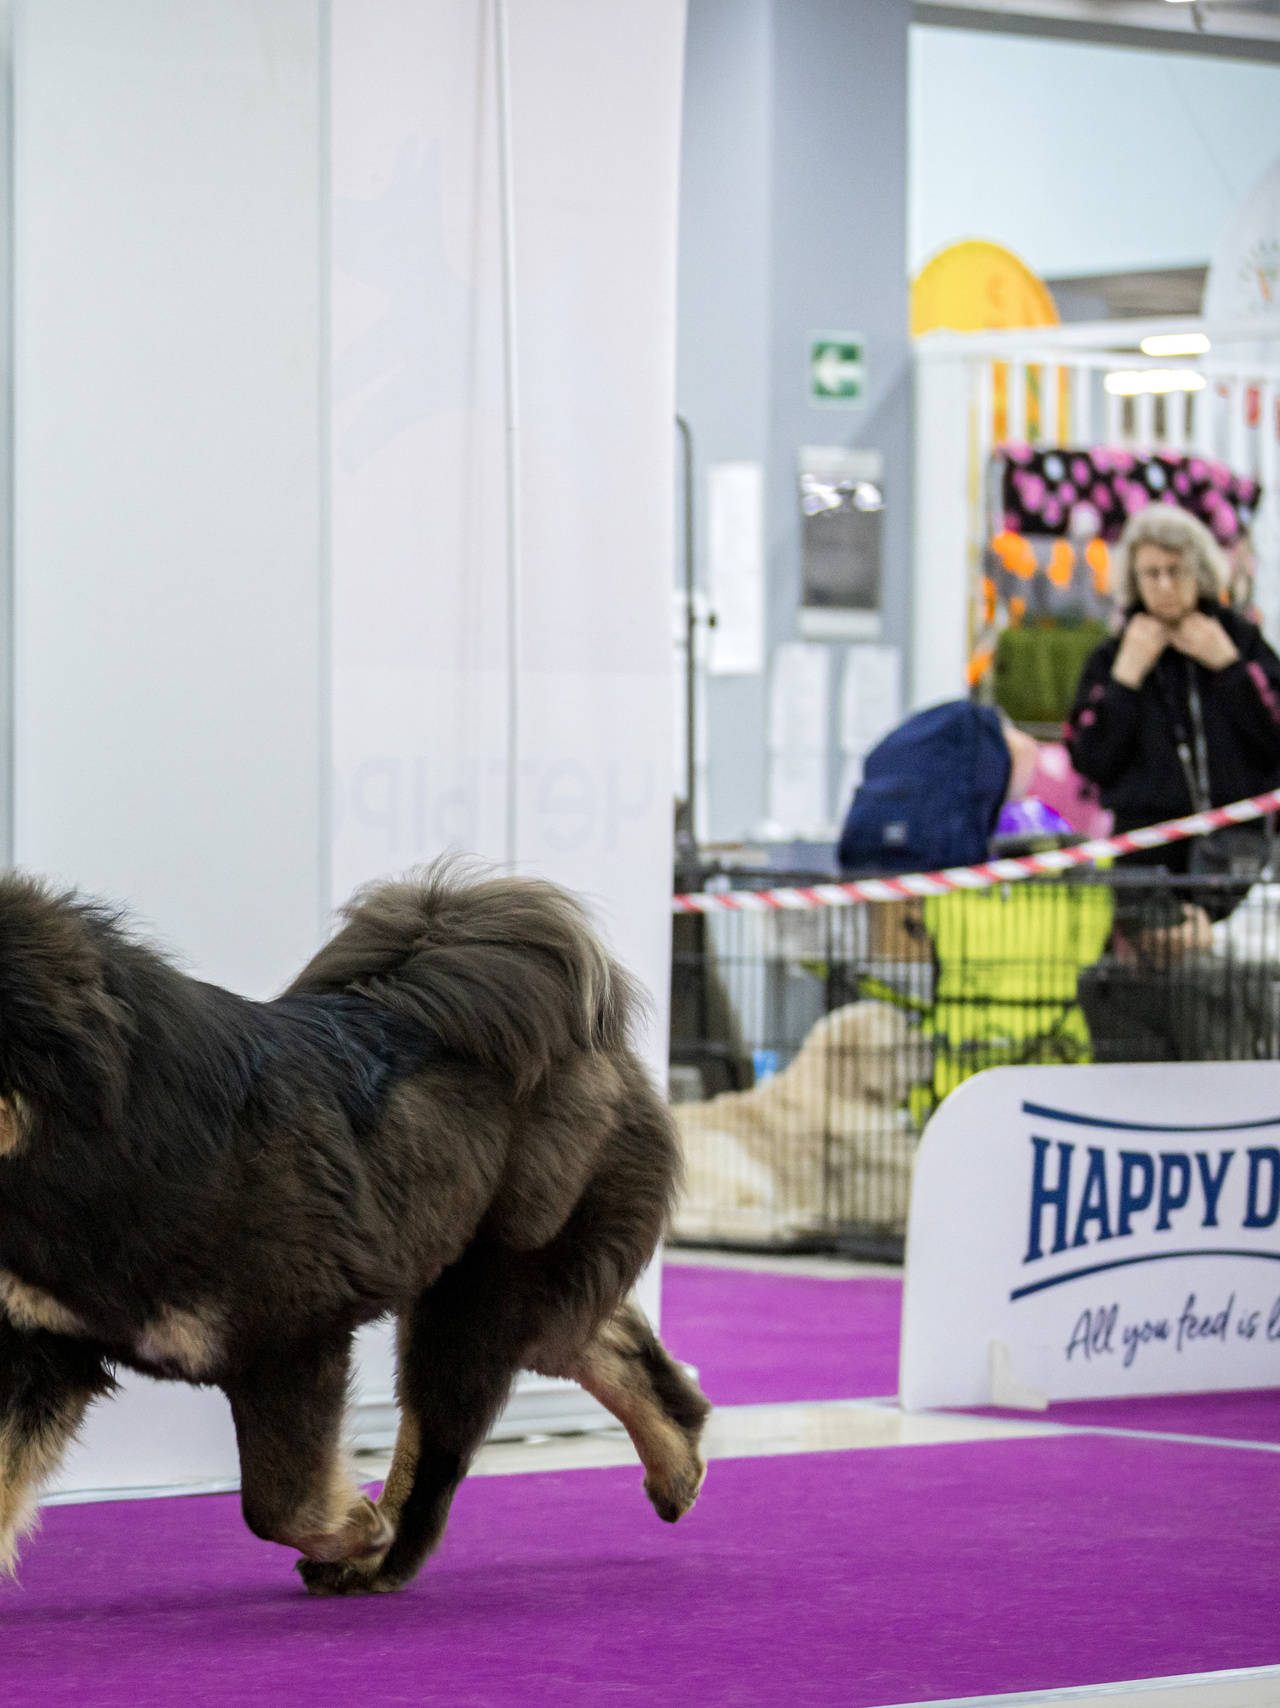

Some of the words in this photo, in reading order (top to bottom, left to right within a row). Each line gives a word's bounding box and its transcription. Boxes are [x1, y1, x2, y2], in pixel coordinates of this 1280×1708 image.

[1023, 1136, 1235, 1264] HAPPY
[1066, 1302, 1119, 1362] All
[1122, 1317, 1170, 1368] you
[1176, 1292, 1235, 1353] feed
[1237, 1307, 1261, 1340] is
